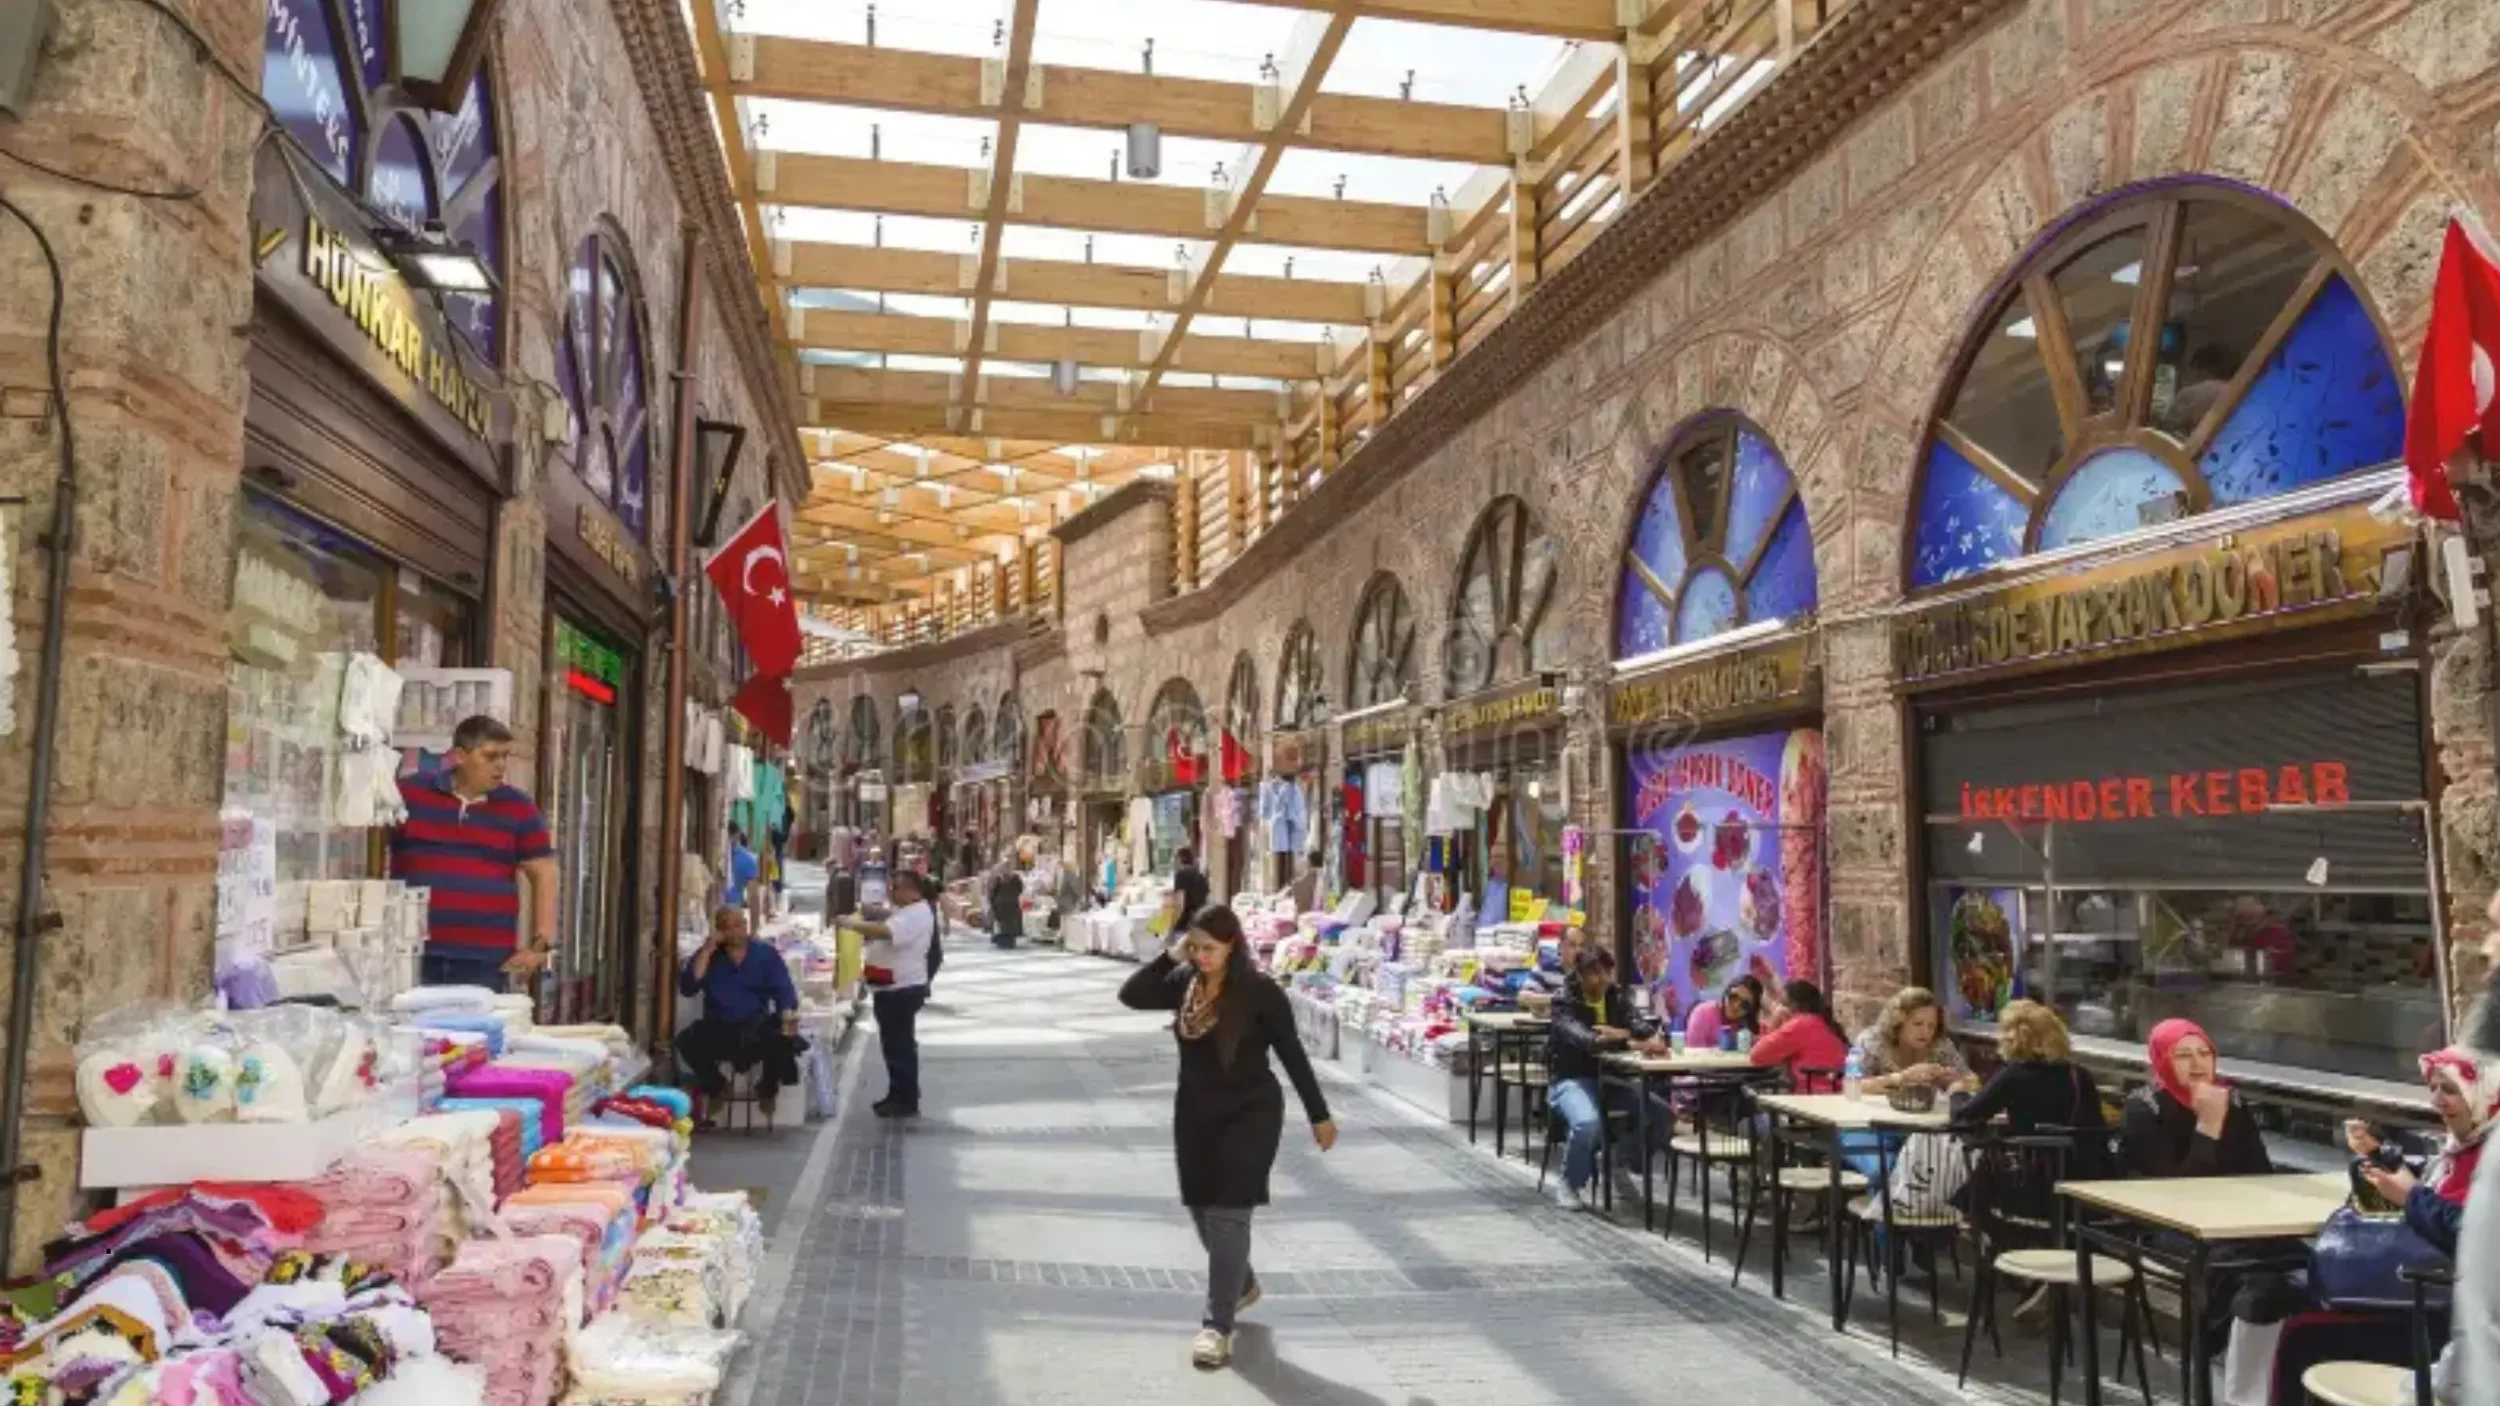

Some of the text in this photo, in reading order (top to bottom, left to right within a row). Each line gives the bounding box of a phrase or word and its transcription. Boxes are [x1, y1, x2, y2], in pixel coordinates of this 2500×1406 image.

[308, 213, 423, 380] HÜNKAR
[2183, 527, 2346, 621] DÖNER
[2169, 761, 2350, 816] KEBAB
